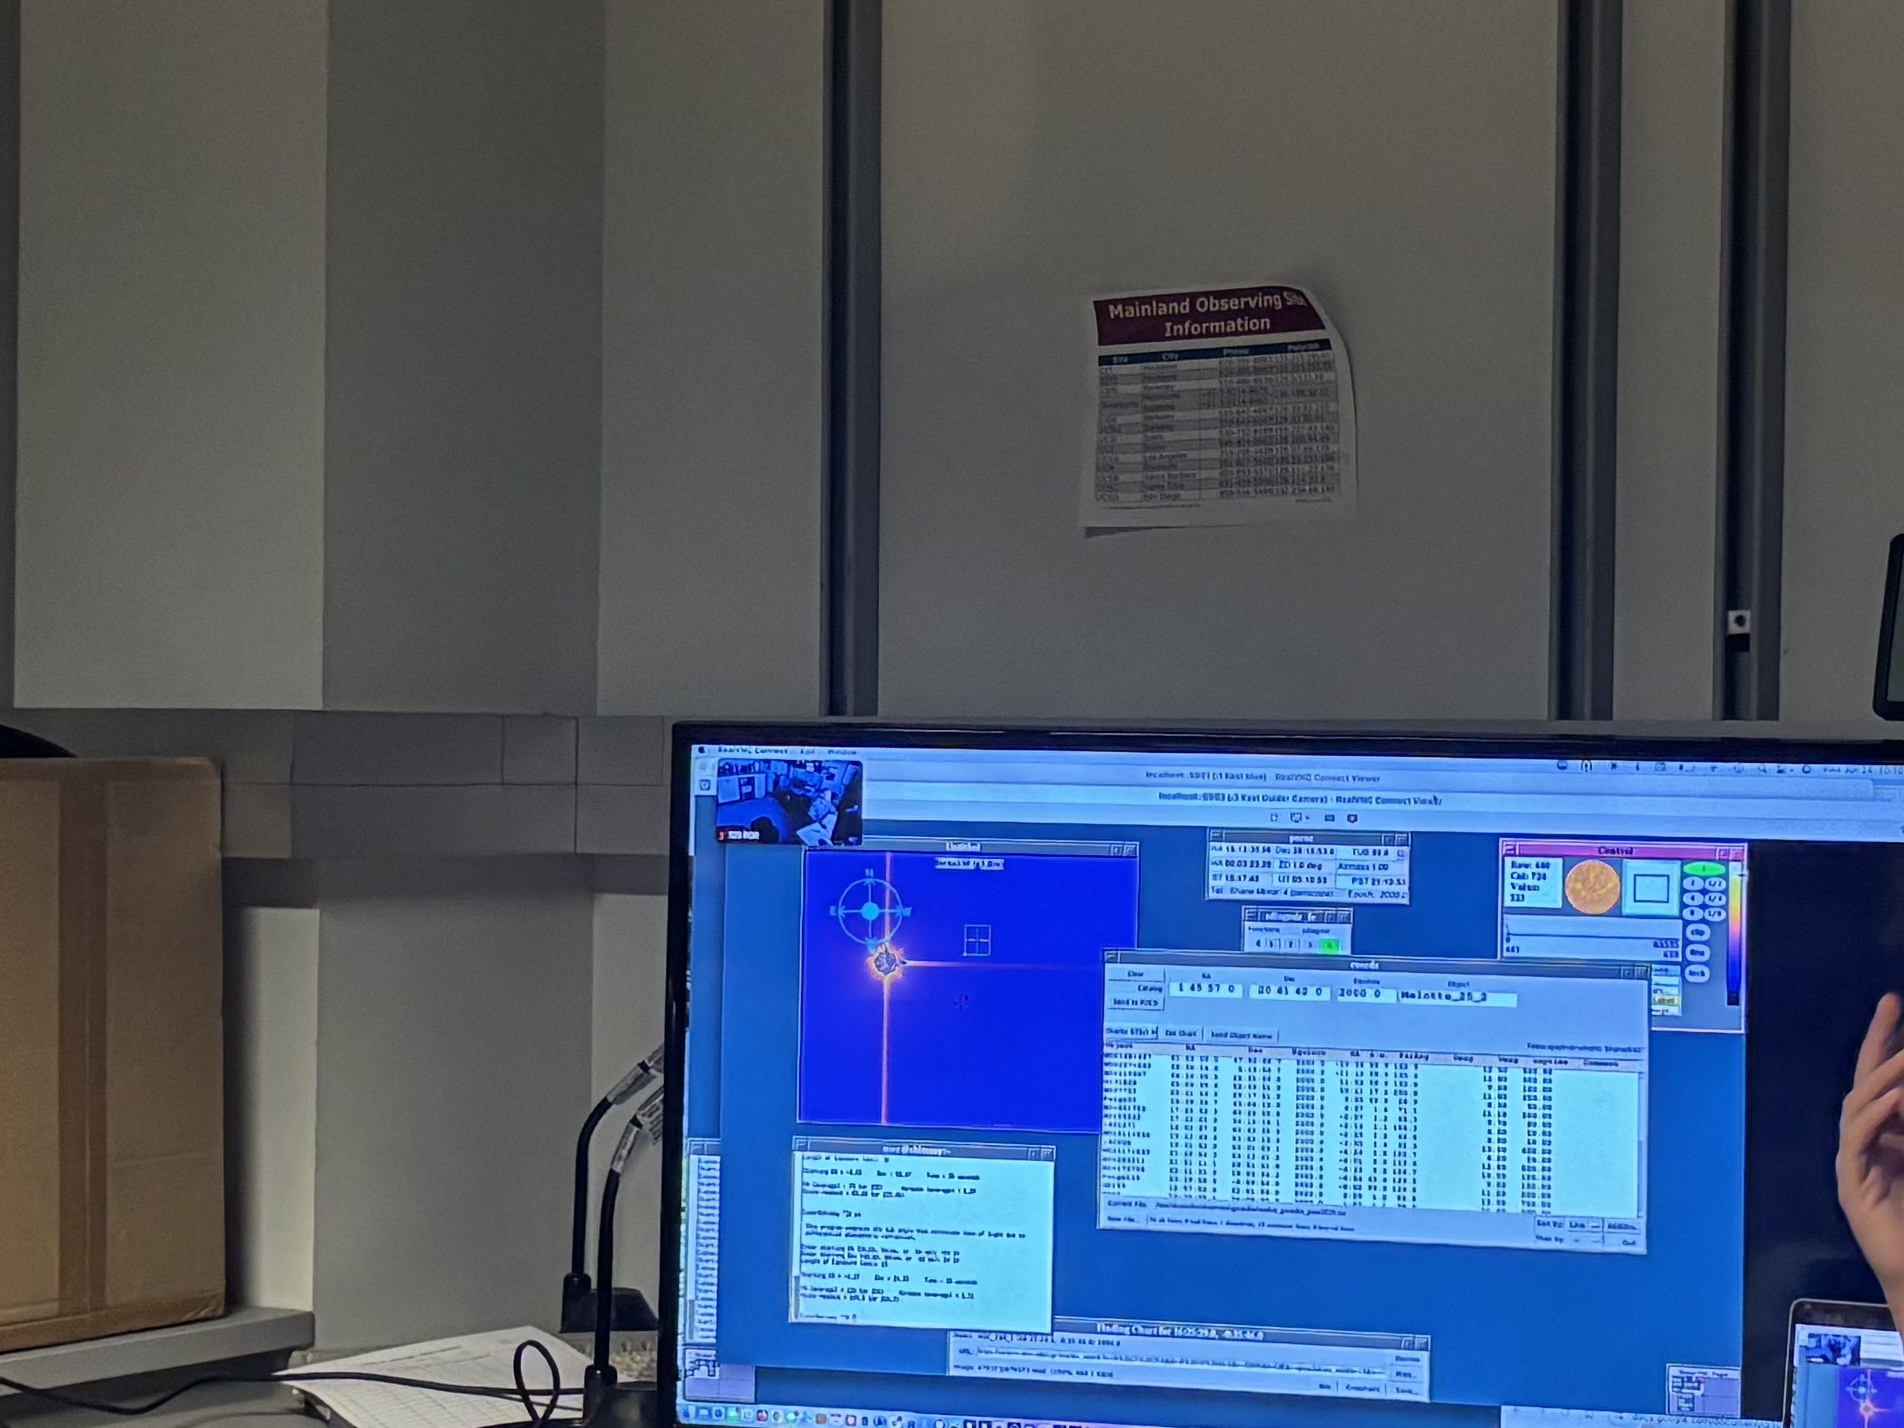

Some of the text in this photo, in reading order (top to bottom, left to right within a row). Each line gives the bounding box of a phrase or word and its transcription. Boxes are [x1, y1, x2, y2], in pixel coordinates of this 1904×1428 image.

[1109, 293, 1282, 319] Mainland Observing
[1165, 316, 1270, 337] Information
